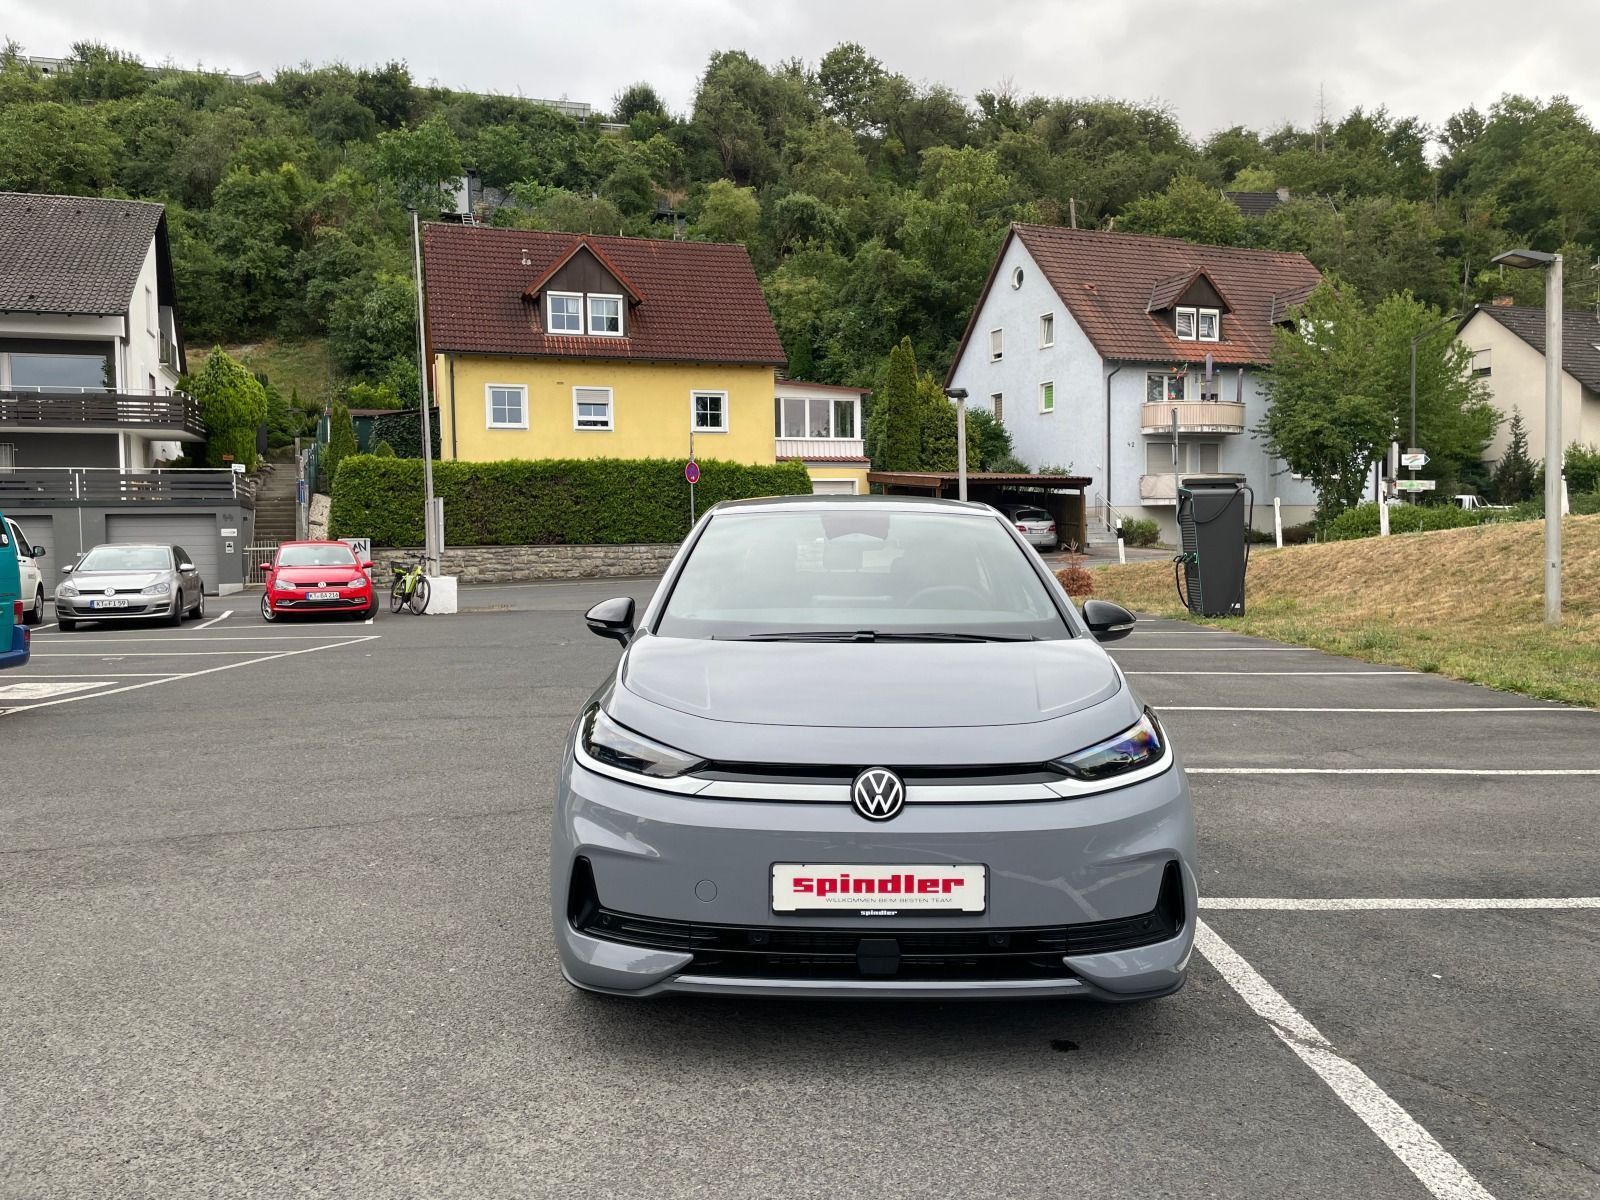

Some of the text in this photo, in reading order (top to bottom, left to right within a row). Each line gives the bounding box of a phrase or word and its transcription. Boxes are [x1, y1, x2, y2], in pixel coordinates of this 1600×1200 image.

[855, 769, 903, 819] VW
[793, 873, 965, 896] spindler
[860, 909, 898, 917] spindler
